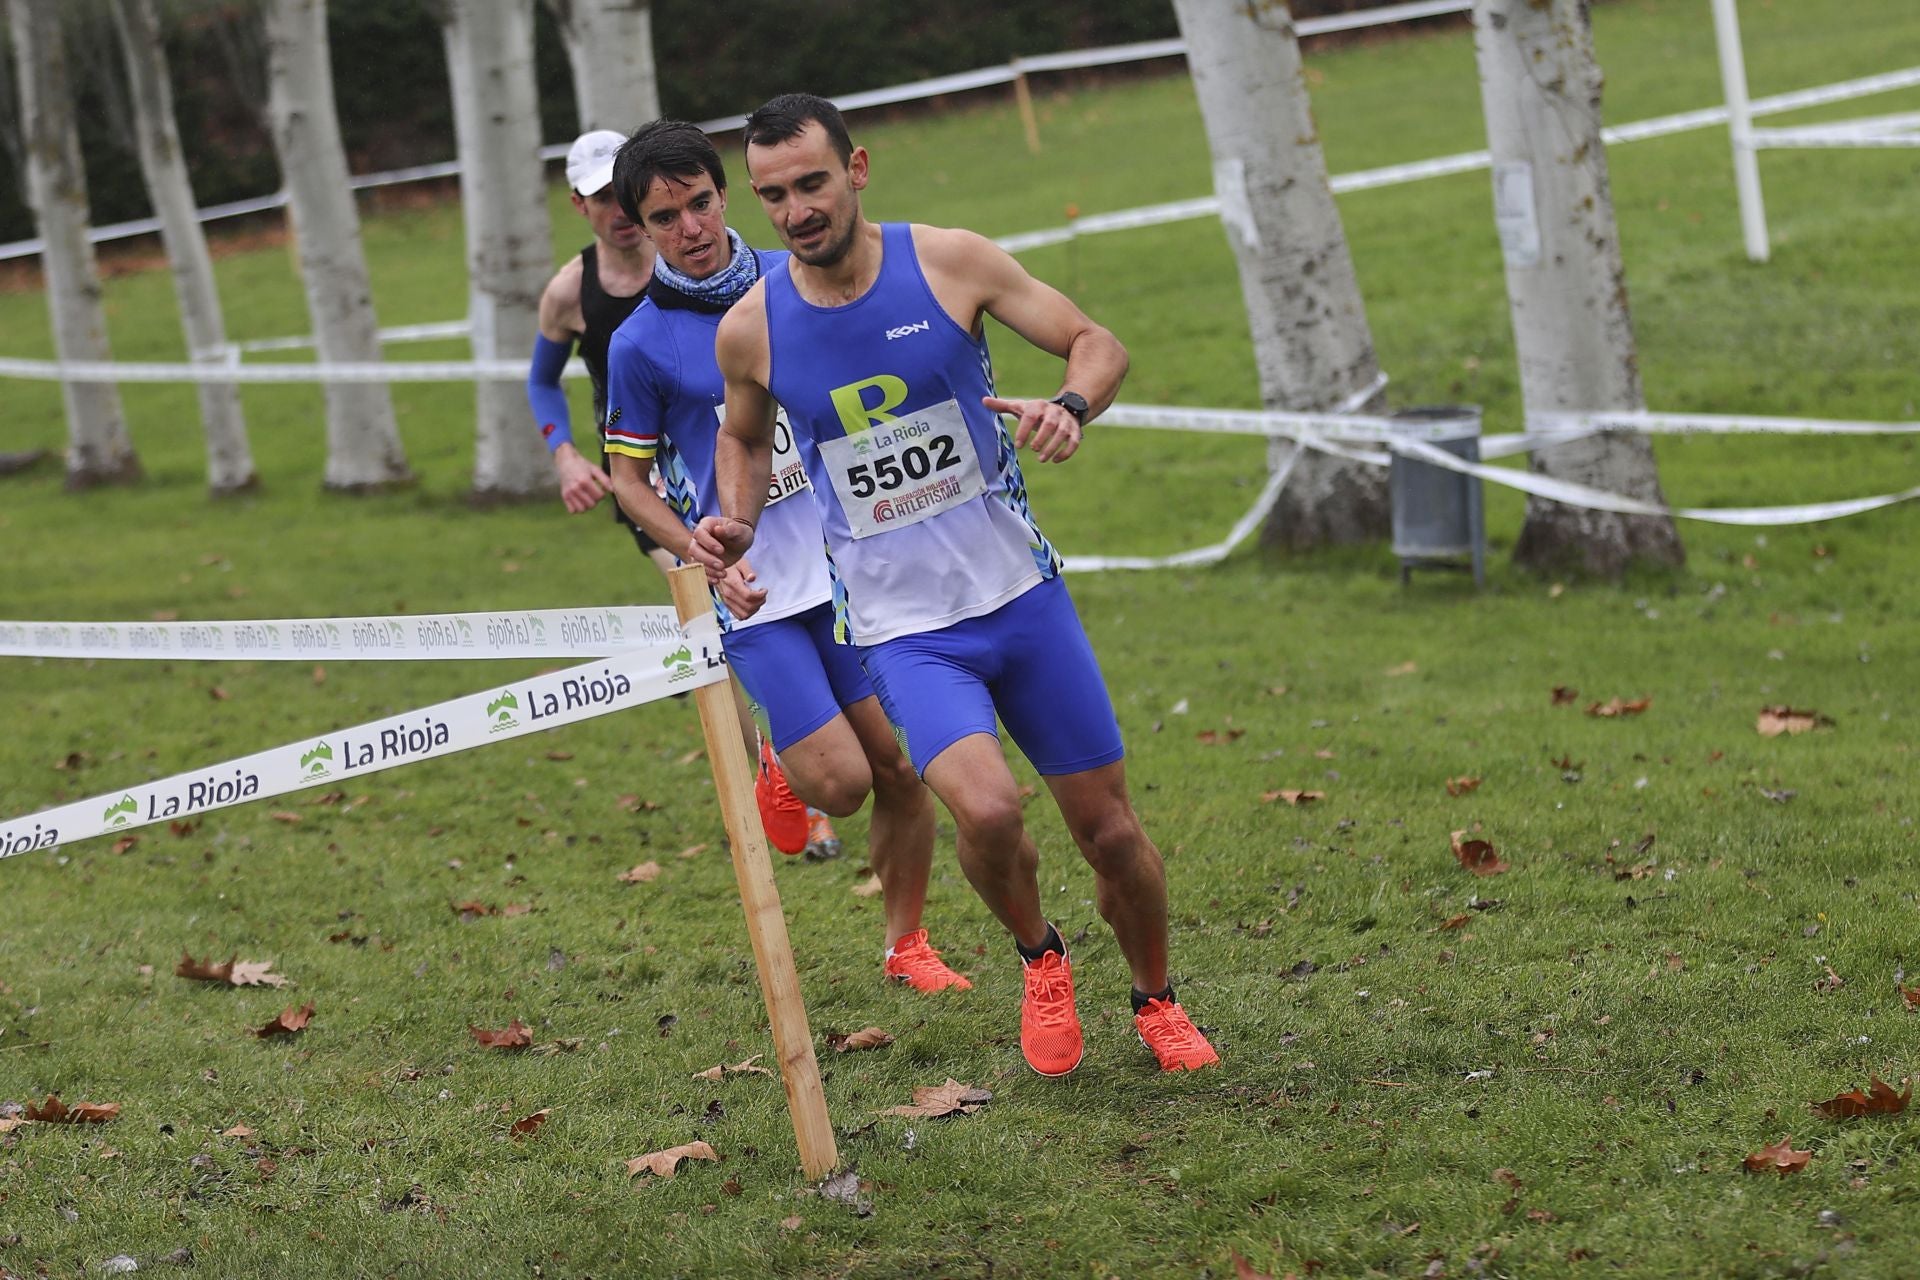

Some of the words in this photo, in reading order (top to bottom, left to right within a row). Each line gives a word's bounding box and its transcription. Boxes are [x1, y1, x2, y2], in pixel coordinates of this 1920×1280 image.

[829, 374, 909, 436] R
[873, 435, 893, 450] La
[893, 420, 930, 443] Rioja
[846, 434, 962, 499] 5502
[895, 481, 962, 517] ATLETISMO
[527, 690, 559, 721] La
[562, 669, 631, 710] Rioja
[343, 741, 374, 770] La
[380, 717, 449, 760] Rioja
[147, 794, 180, 821] La
[187, 769, 259, 811] Rioja
